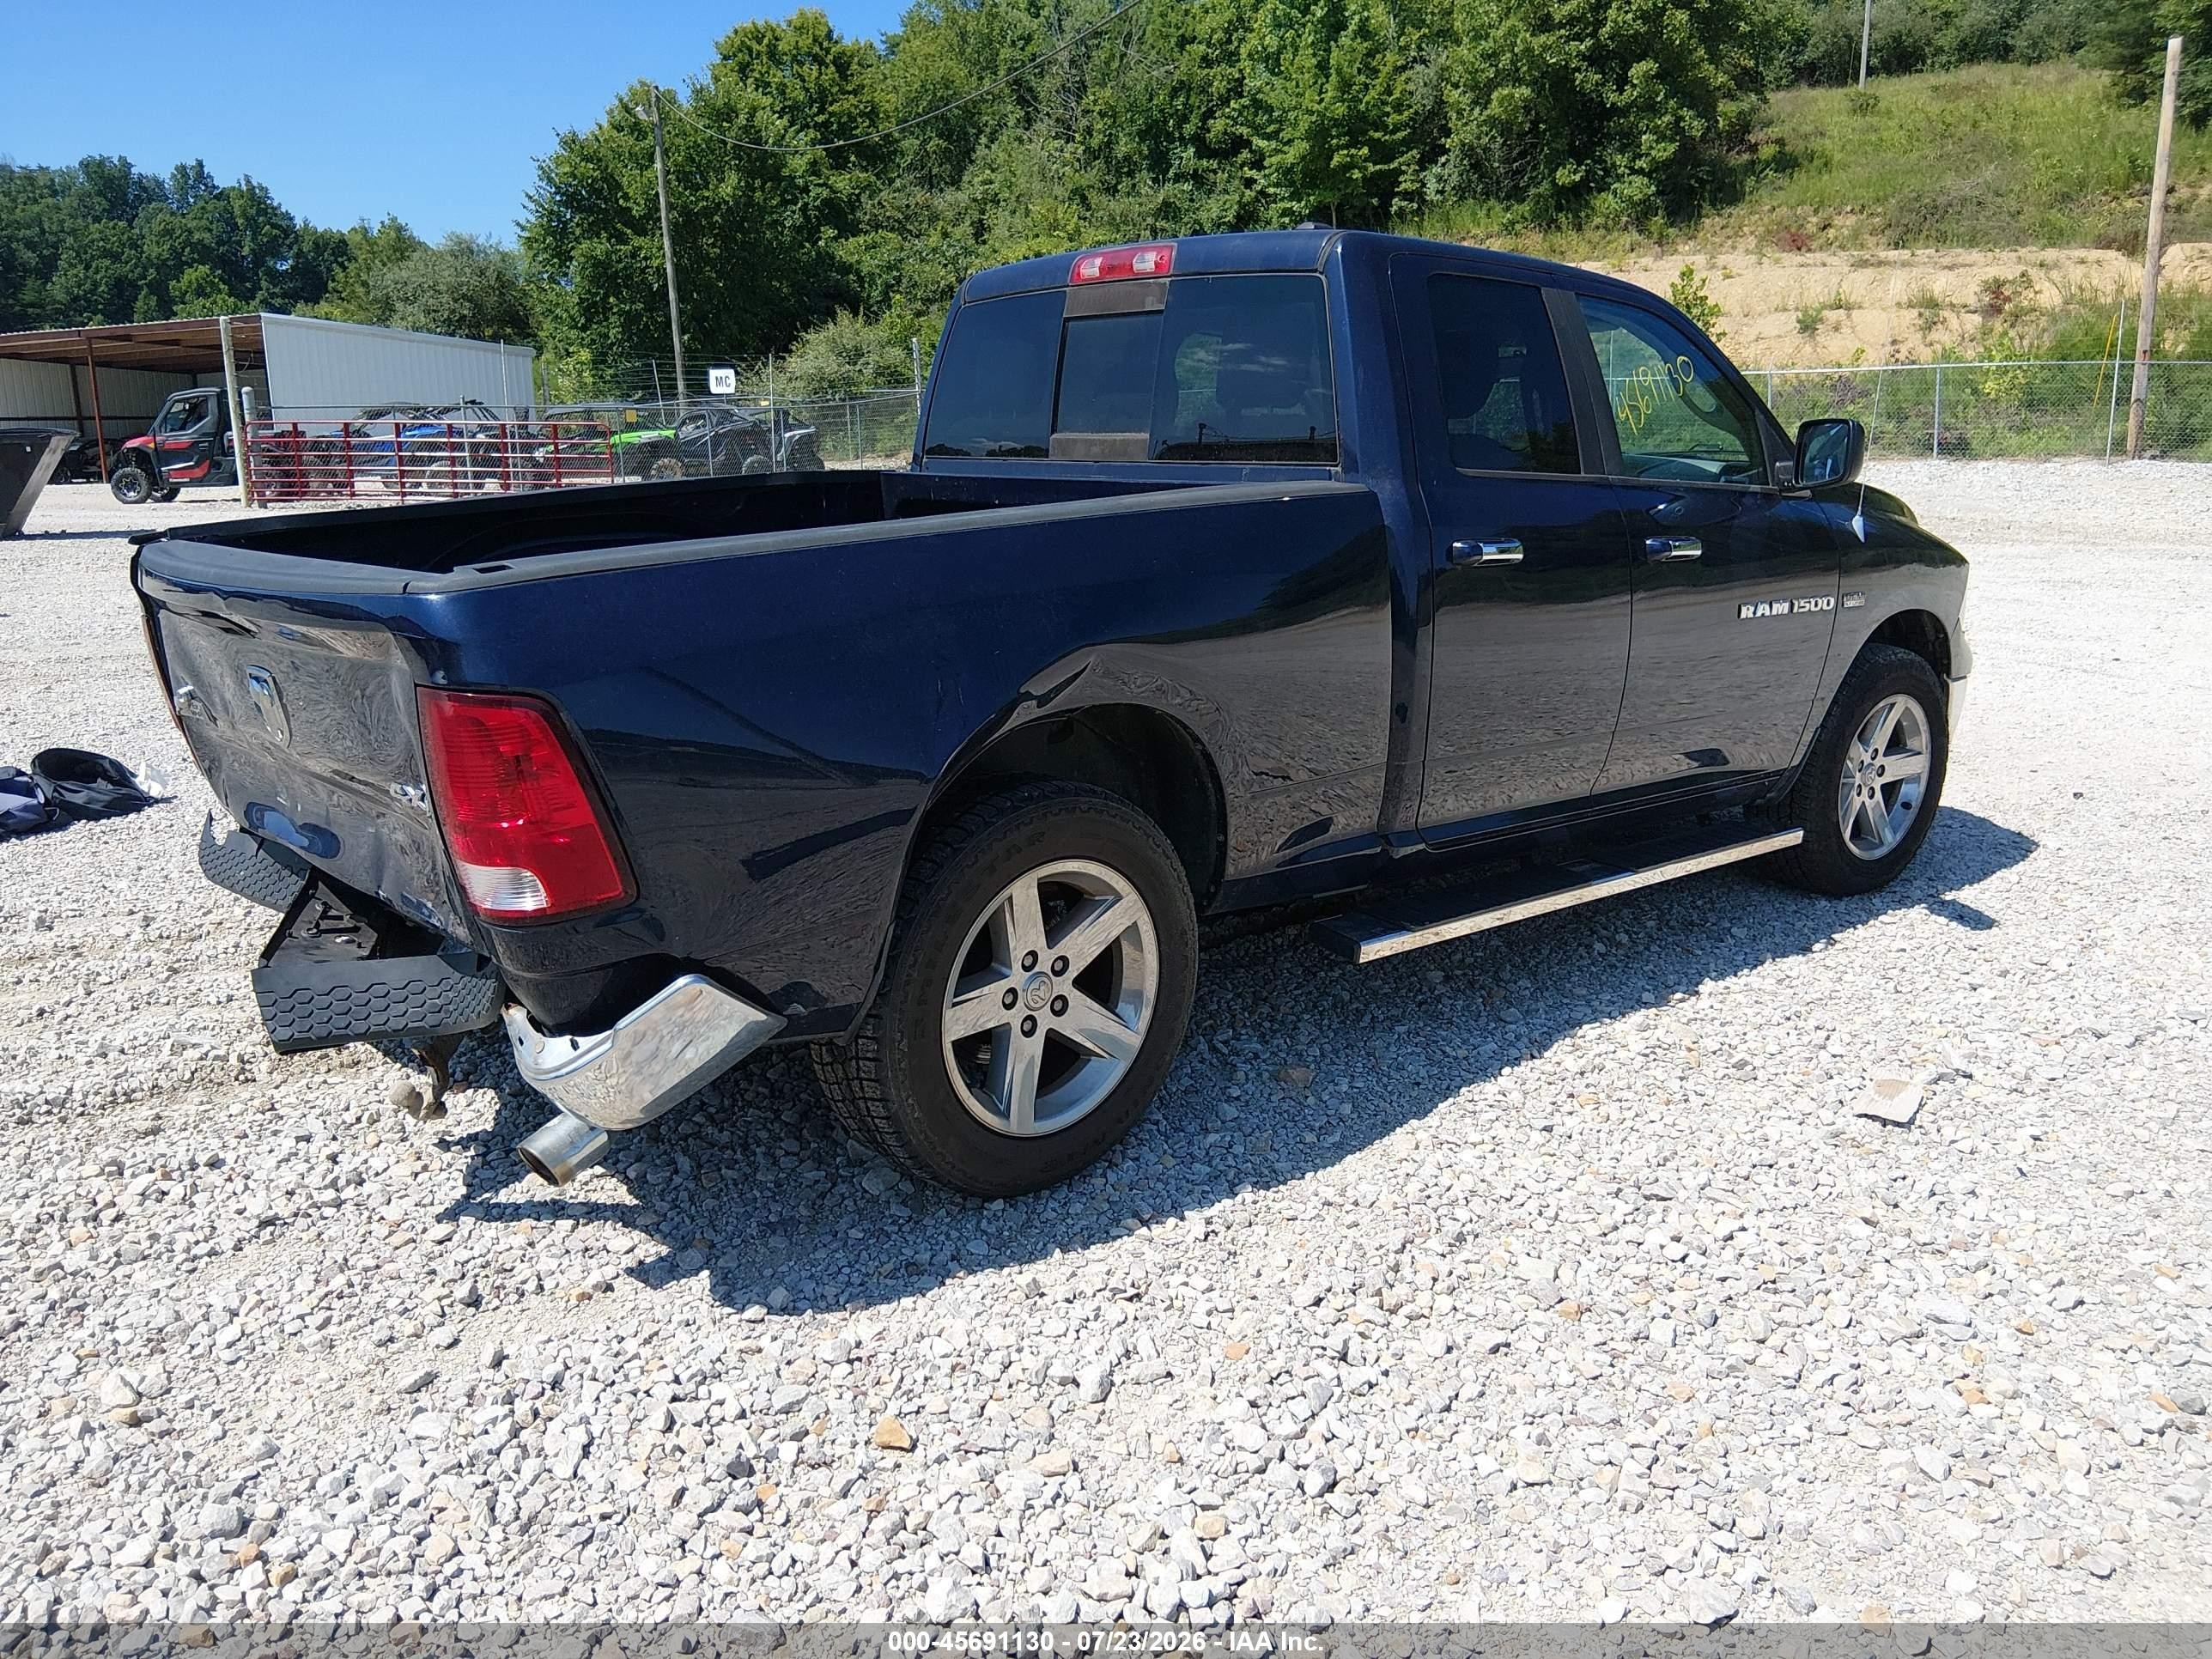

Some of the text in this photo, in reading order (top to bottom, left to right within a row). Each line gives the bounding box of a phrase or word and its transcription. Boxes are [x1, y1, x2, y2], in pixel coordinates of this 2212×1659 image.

[714, 375, 731, 388] MC
[1739, 600, 1790, 620] RAM
[1792, 596, 1835, 613] 1500
